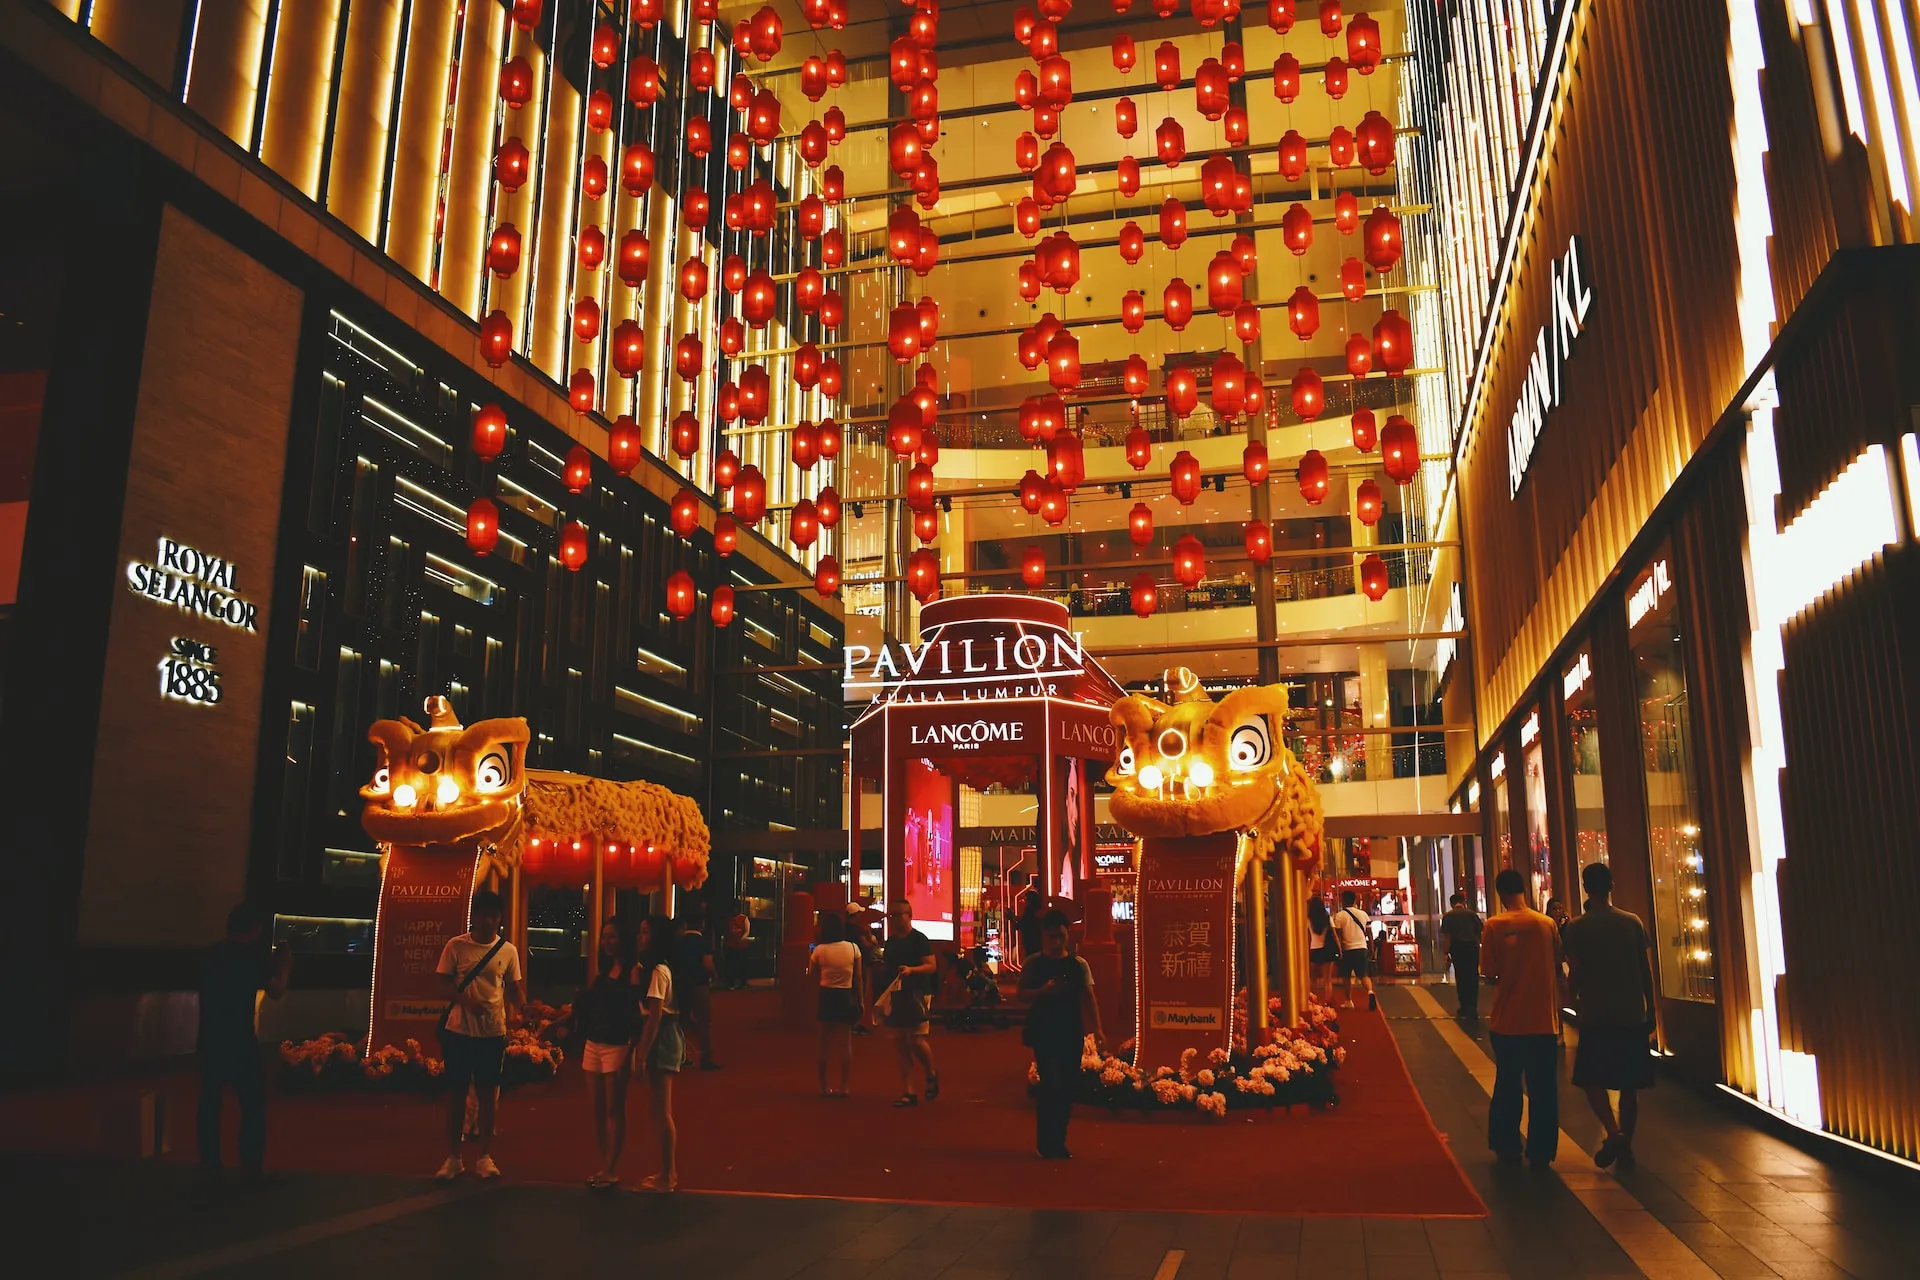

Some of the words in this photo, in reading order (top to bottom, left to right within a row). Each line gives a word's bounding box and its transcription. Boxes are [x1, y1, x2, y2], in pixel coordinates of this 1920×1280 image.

[161, 539, 241, 593] ROYAL
[130, 562, 259, 631] SELANGOR
[842, 631, 1085, 680] PAVILION
[162, 658, 223, 705] 1885
[871, 690, 945, 705] KUALA
[963, 683, 1058, 700] LUMPUR
[910, 719, 1024, 744] LANCÔME
[1061, 720, 1117, 747] LANCÔ
[1090, 746, 1109, 754] PARIS
[391, 885, 462, 896] PAVILION
[1147, 878, 1224, 891] PAVILION
[1161, 920, 1212, 947] 恭賀
[404, 948, 435, 961] NEW
[1161, 950, 1212, 978] 新禧
[1167, 1012, 1216, 1025] Maybank
